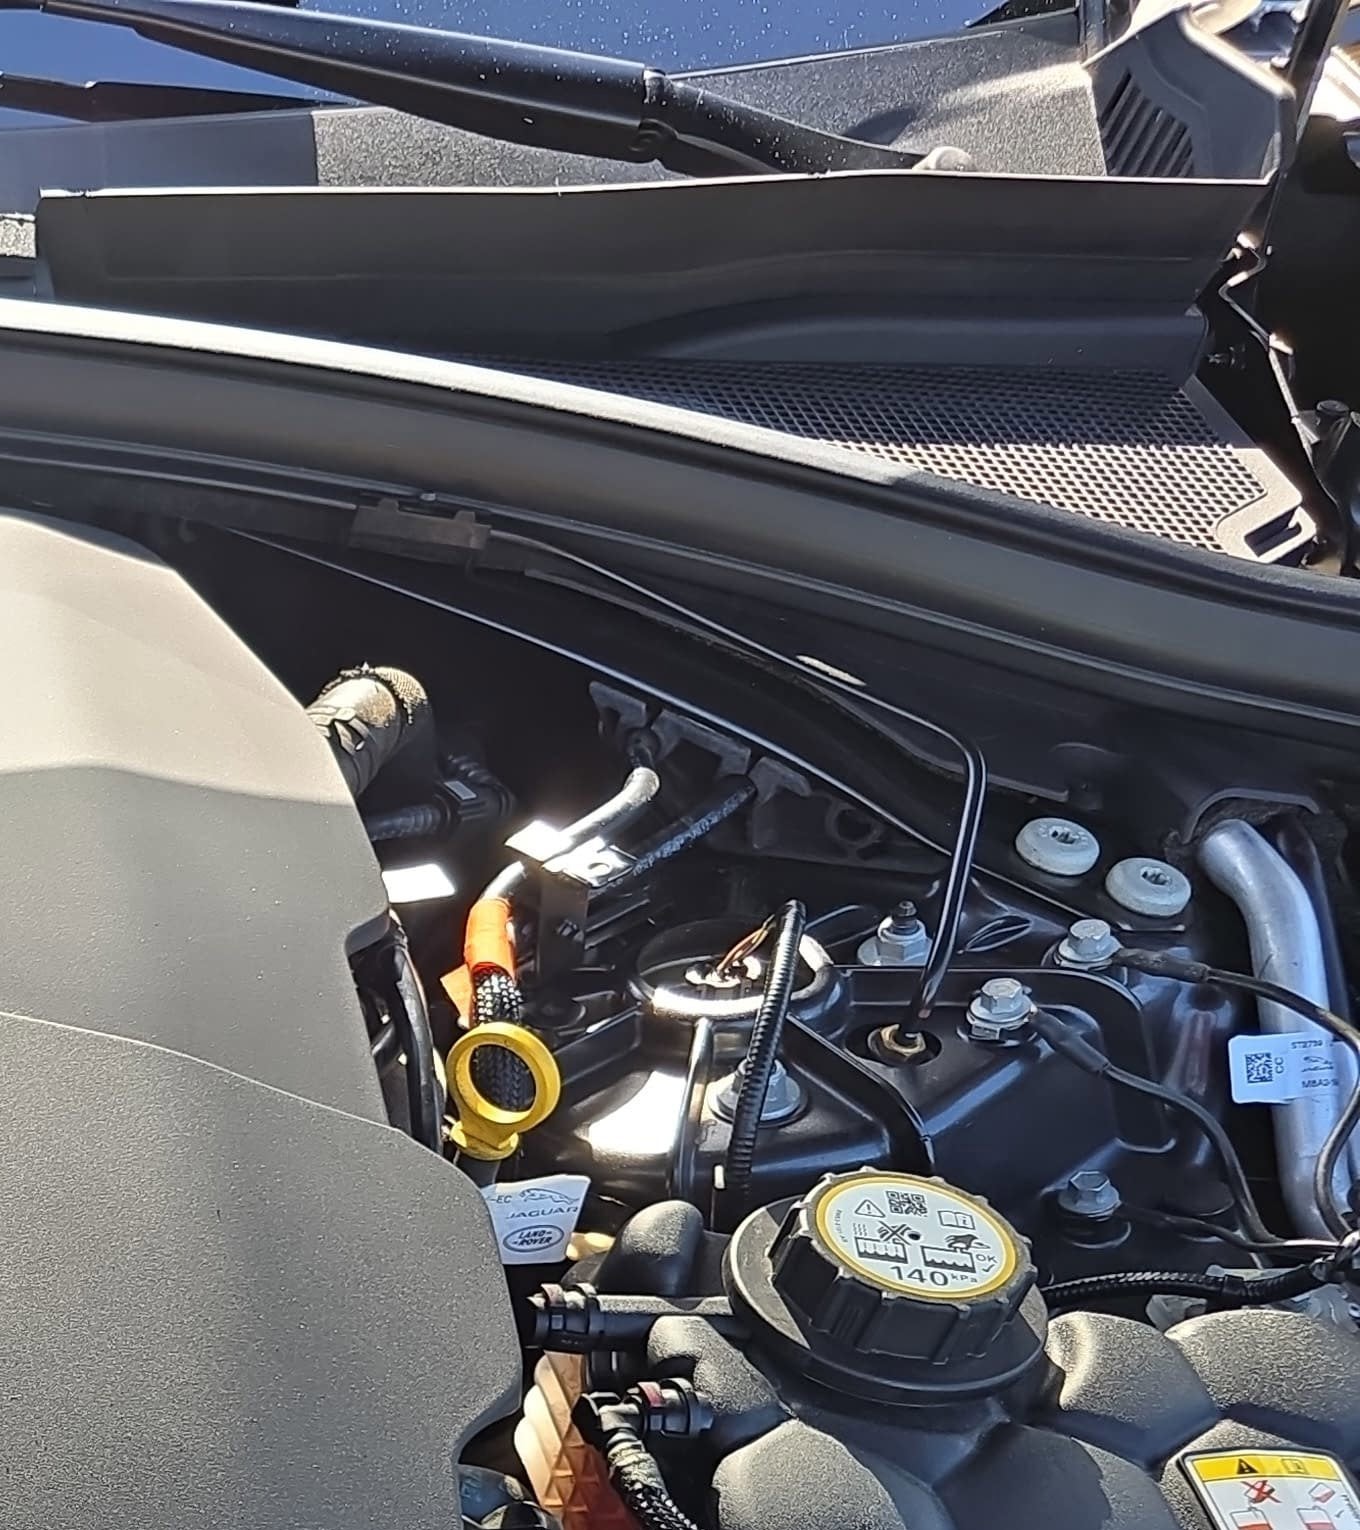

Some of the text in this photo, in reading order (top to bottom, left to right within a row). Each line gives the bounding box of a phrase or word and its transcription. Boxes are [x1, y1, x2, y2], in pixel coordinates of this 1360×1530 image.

[505, 1206, 578, 1219] JAGUAR
[975, 1254, 998, 1265] OK
[890, 1265, 949, 1287] 140
